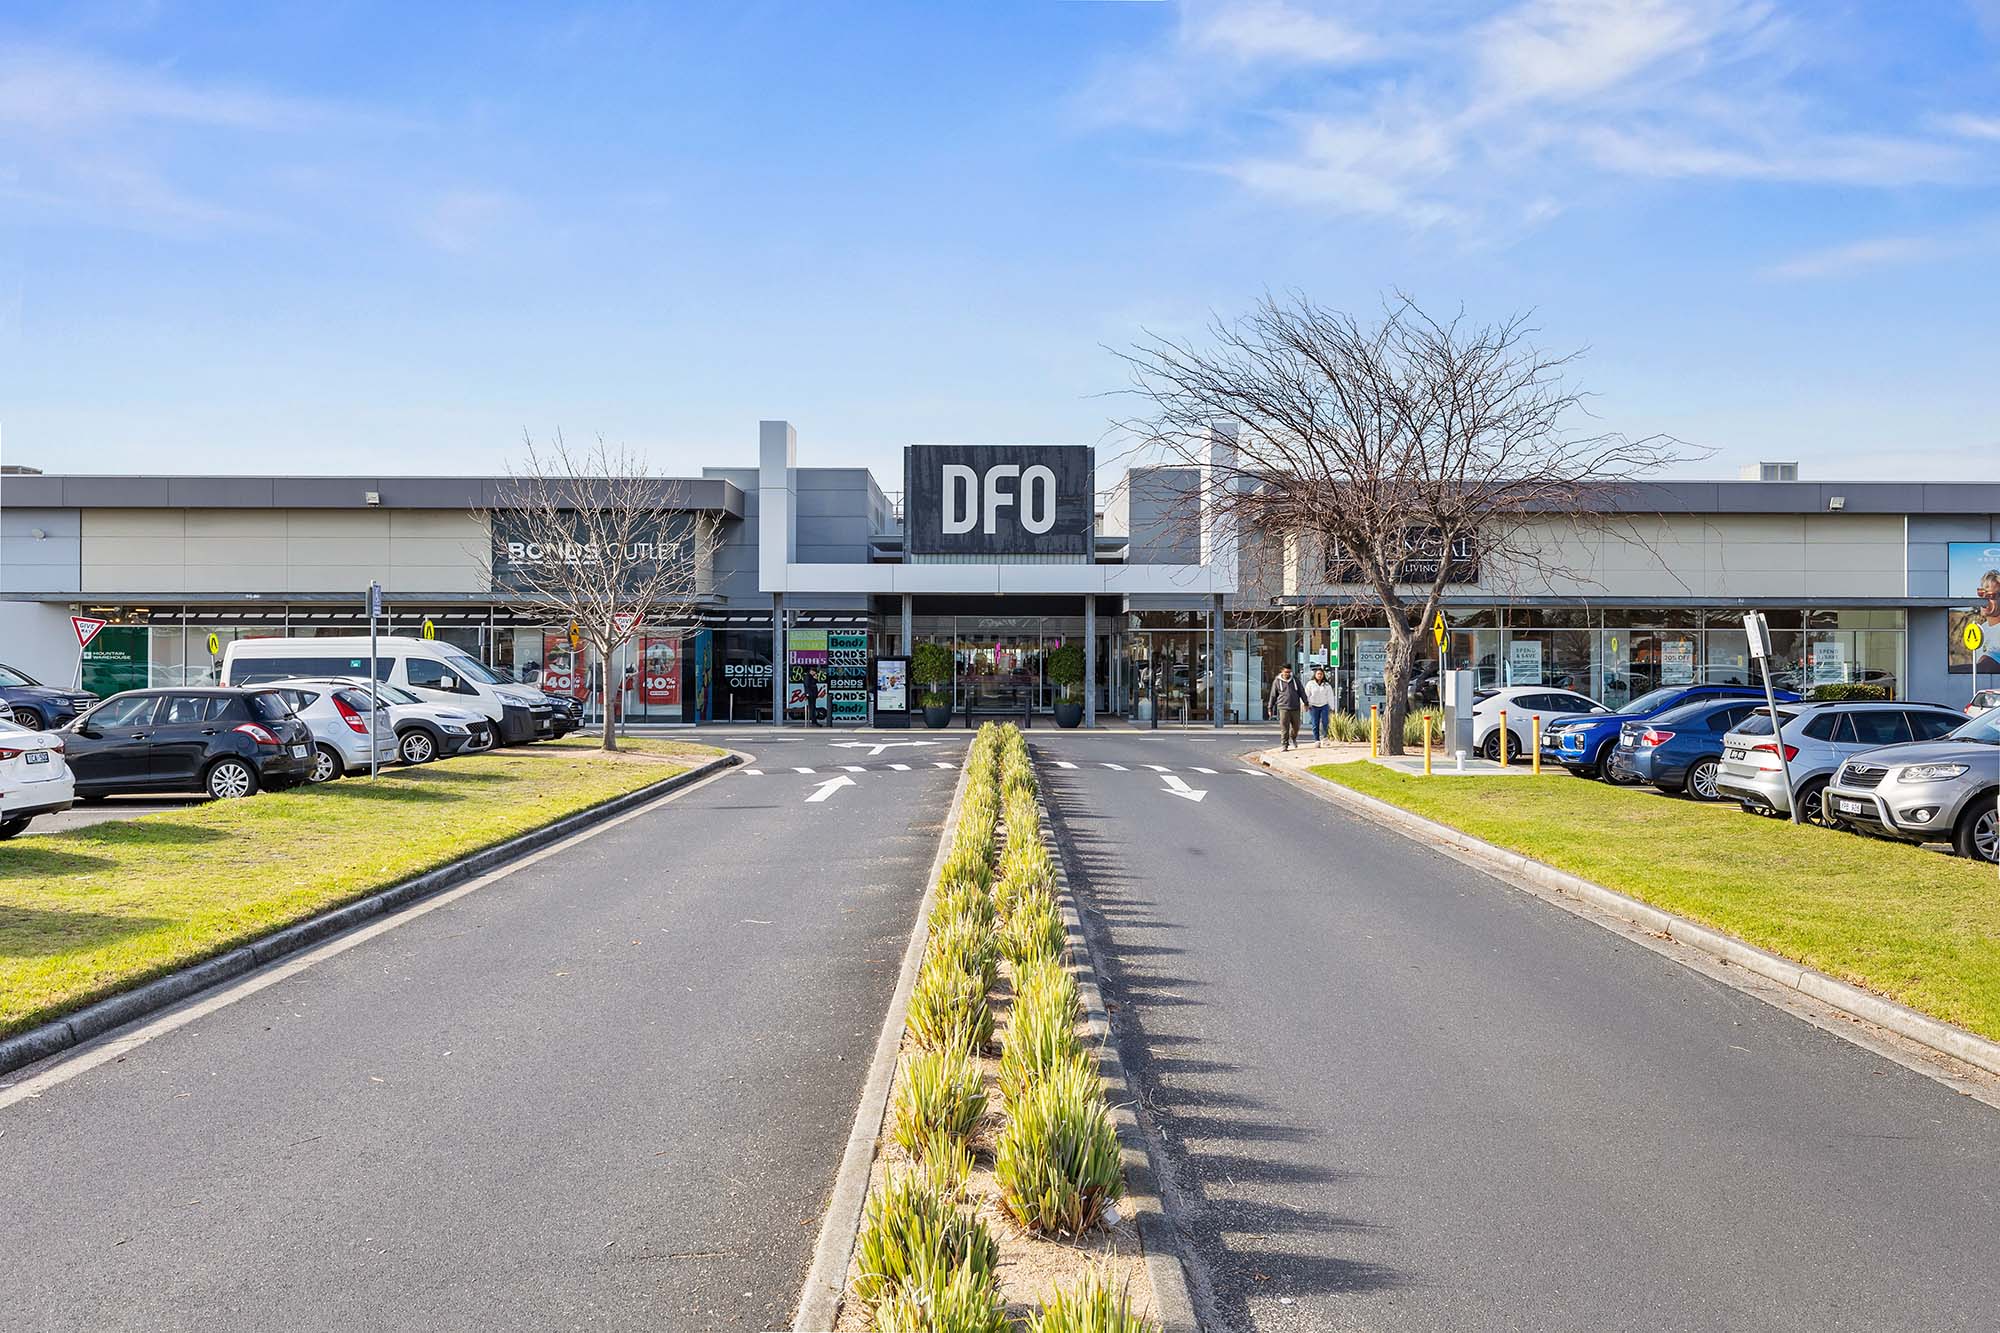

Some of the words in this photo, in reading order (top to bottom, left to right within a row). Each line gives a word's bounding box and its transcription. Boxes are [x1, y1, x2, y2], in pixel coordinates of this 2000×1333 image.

[942, 465, 1056, 534] DFO
[1405, 564, 1438, 573] LIVING
[80, 622, 95, 630] GIVE
[725, 664, 773, 674] BONDS
[730, 678, 769, 688] OUTLET
